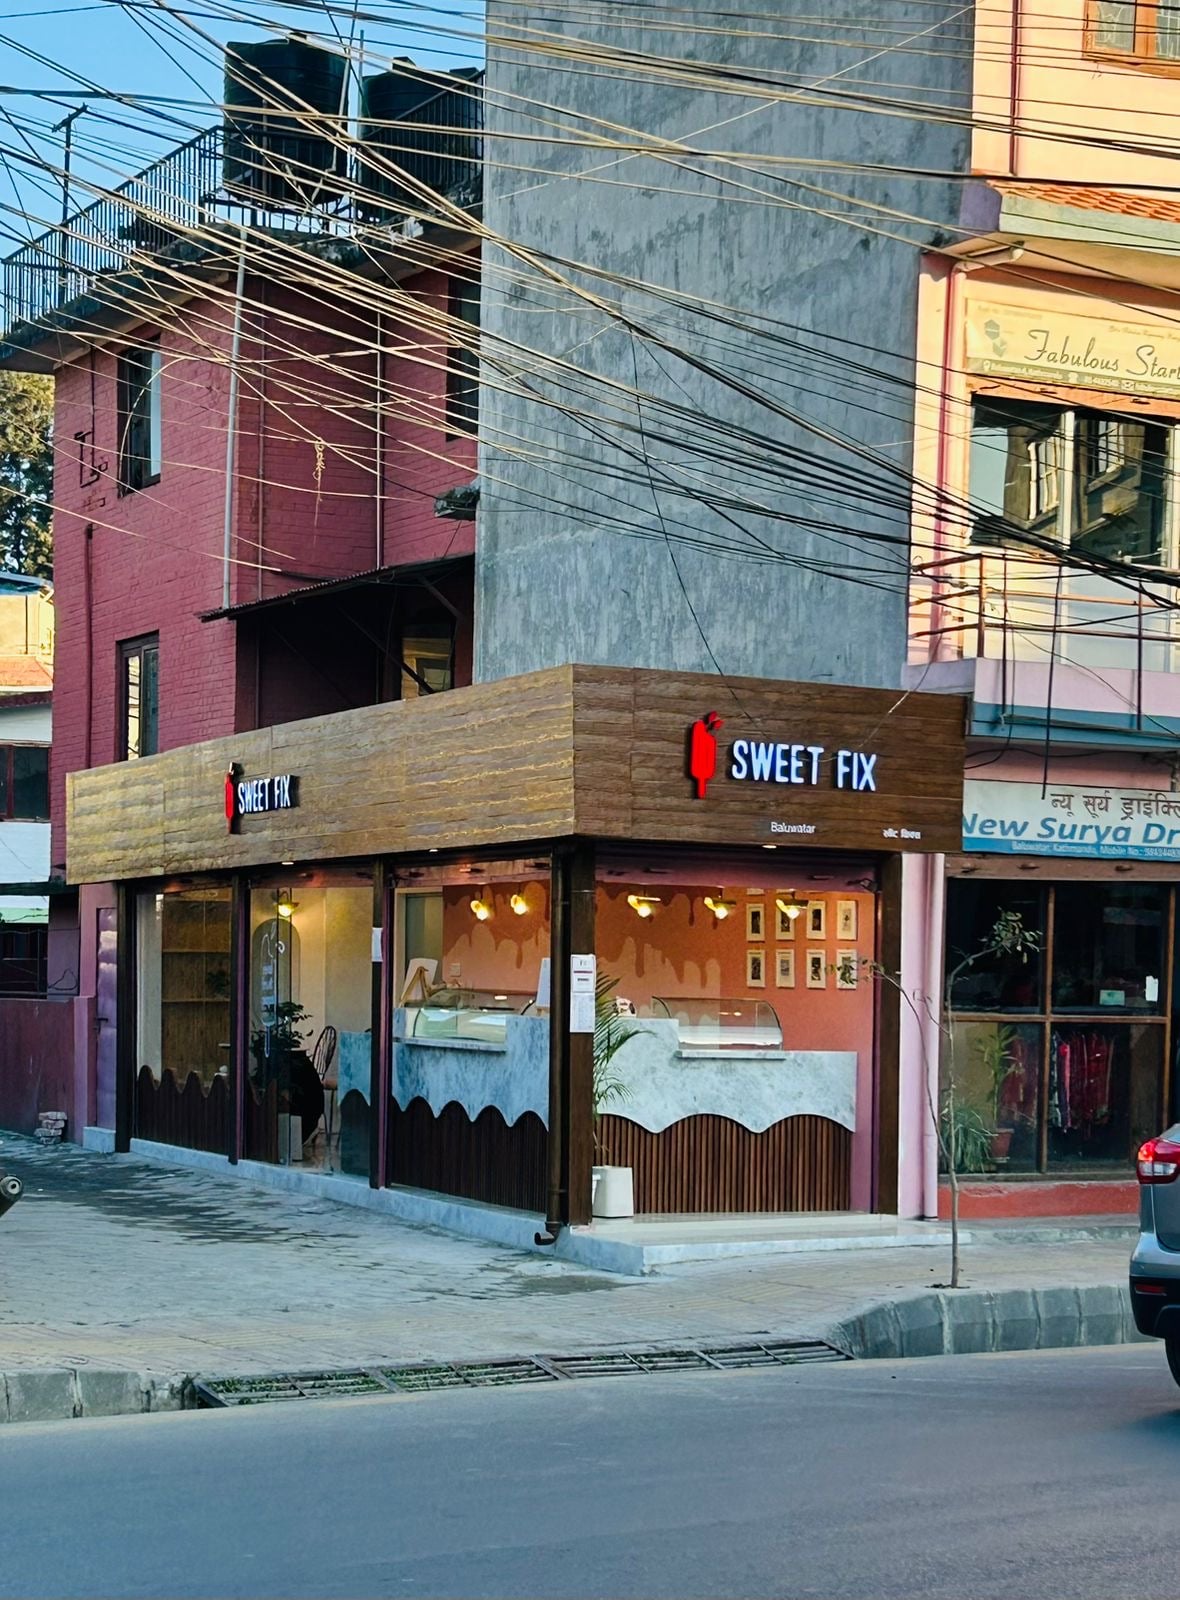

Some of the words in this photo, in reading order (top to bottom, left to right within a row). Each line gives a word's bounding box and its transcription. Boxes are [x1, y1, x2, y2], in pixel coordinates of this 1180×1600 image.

[1024, 329, 1119, 372] Fabulous
[731, 739, 824, 785] SWEET
[836, 750, 876, 791] FIX
[237, 778, 270, 814] SWEET
[274, 774, 291, 808] FIX
[1083, 790, 1112, 818] सूर्य
[963, 813, 1029, 836] New
[1037, 817, 1132, 846] Surya
[1142, 823, 1180, 845] Dr
